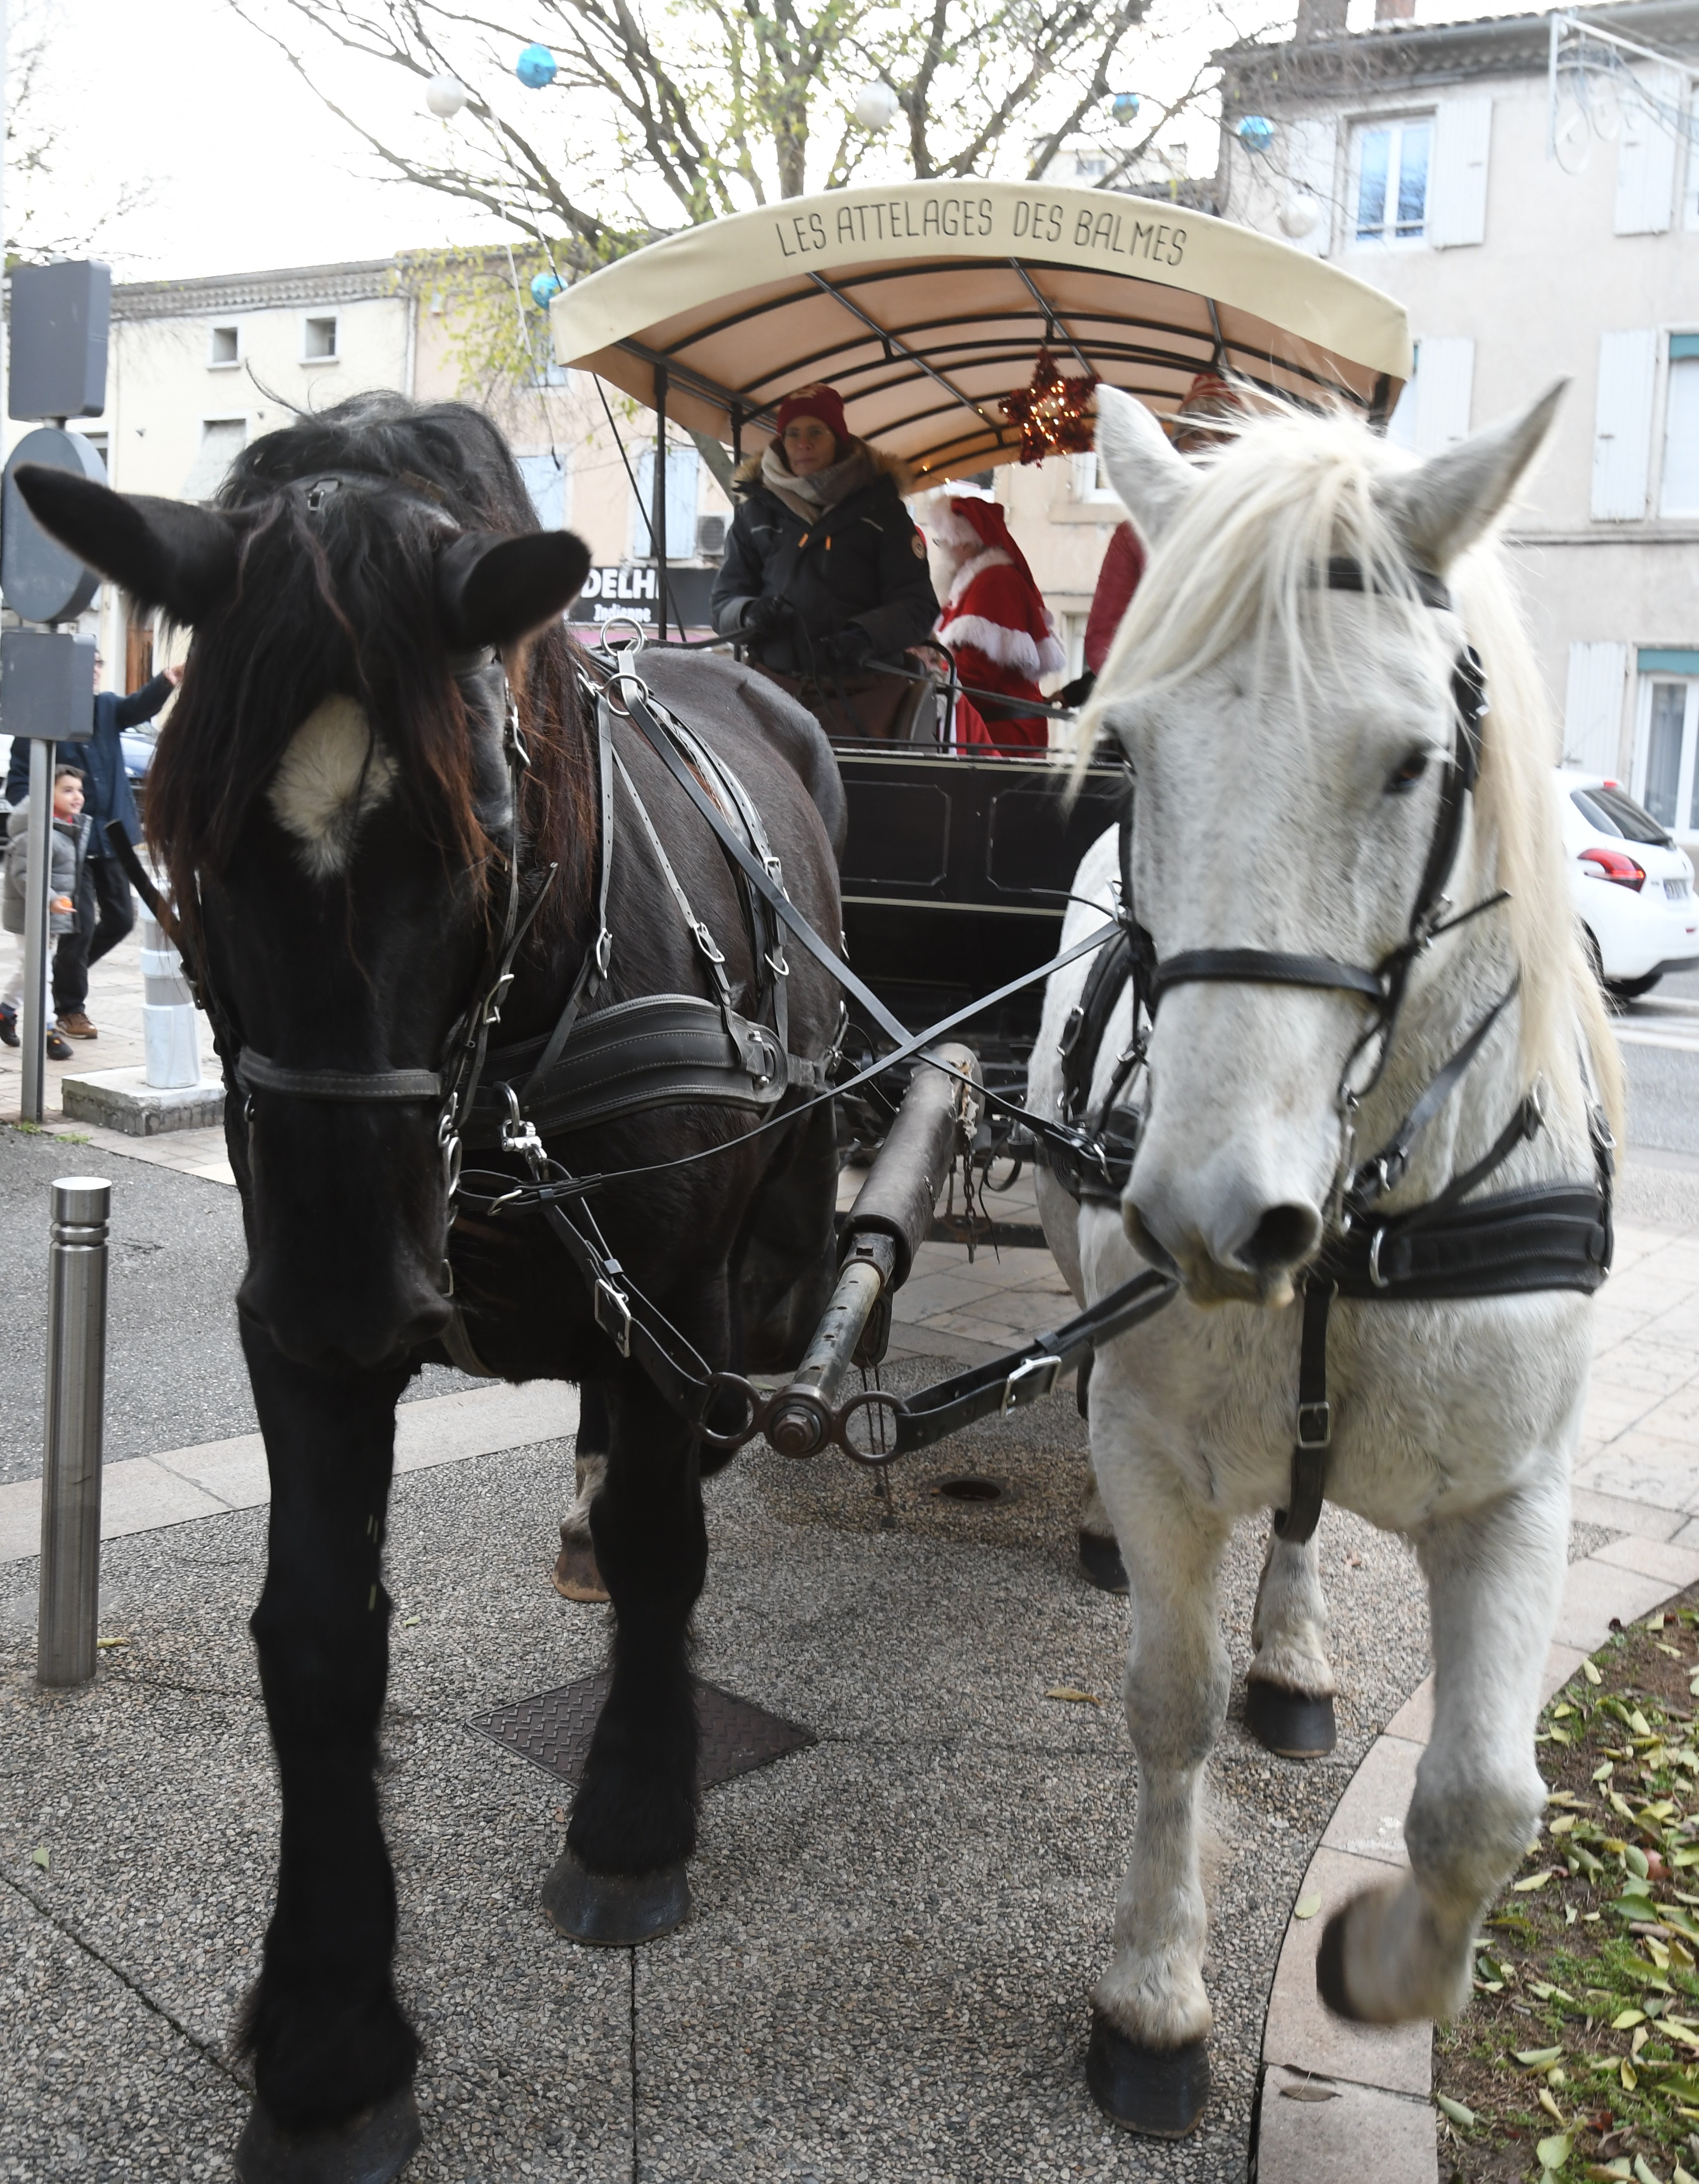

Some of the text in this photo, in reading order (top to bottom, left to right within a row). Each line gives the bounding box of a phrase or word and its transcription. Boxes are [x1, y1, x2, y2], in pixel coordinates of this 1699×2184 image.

[776, 198, 1188, 266] LES ATTELAGES DES BALMES
